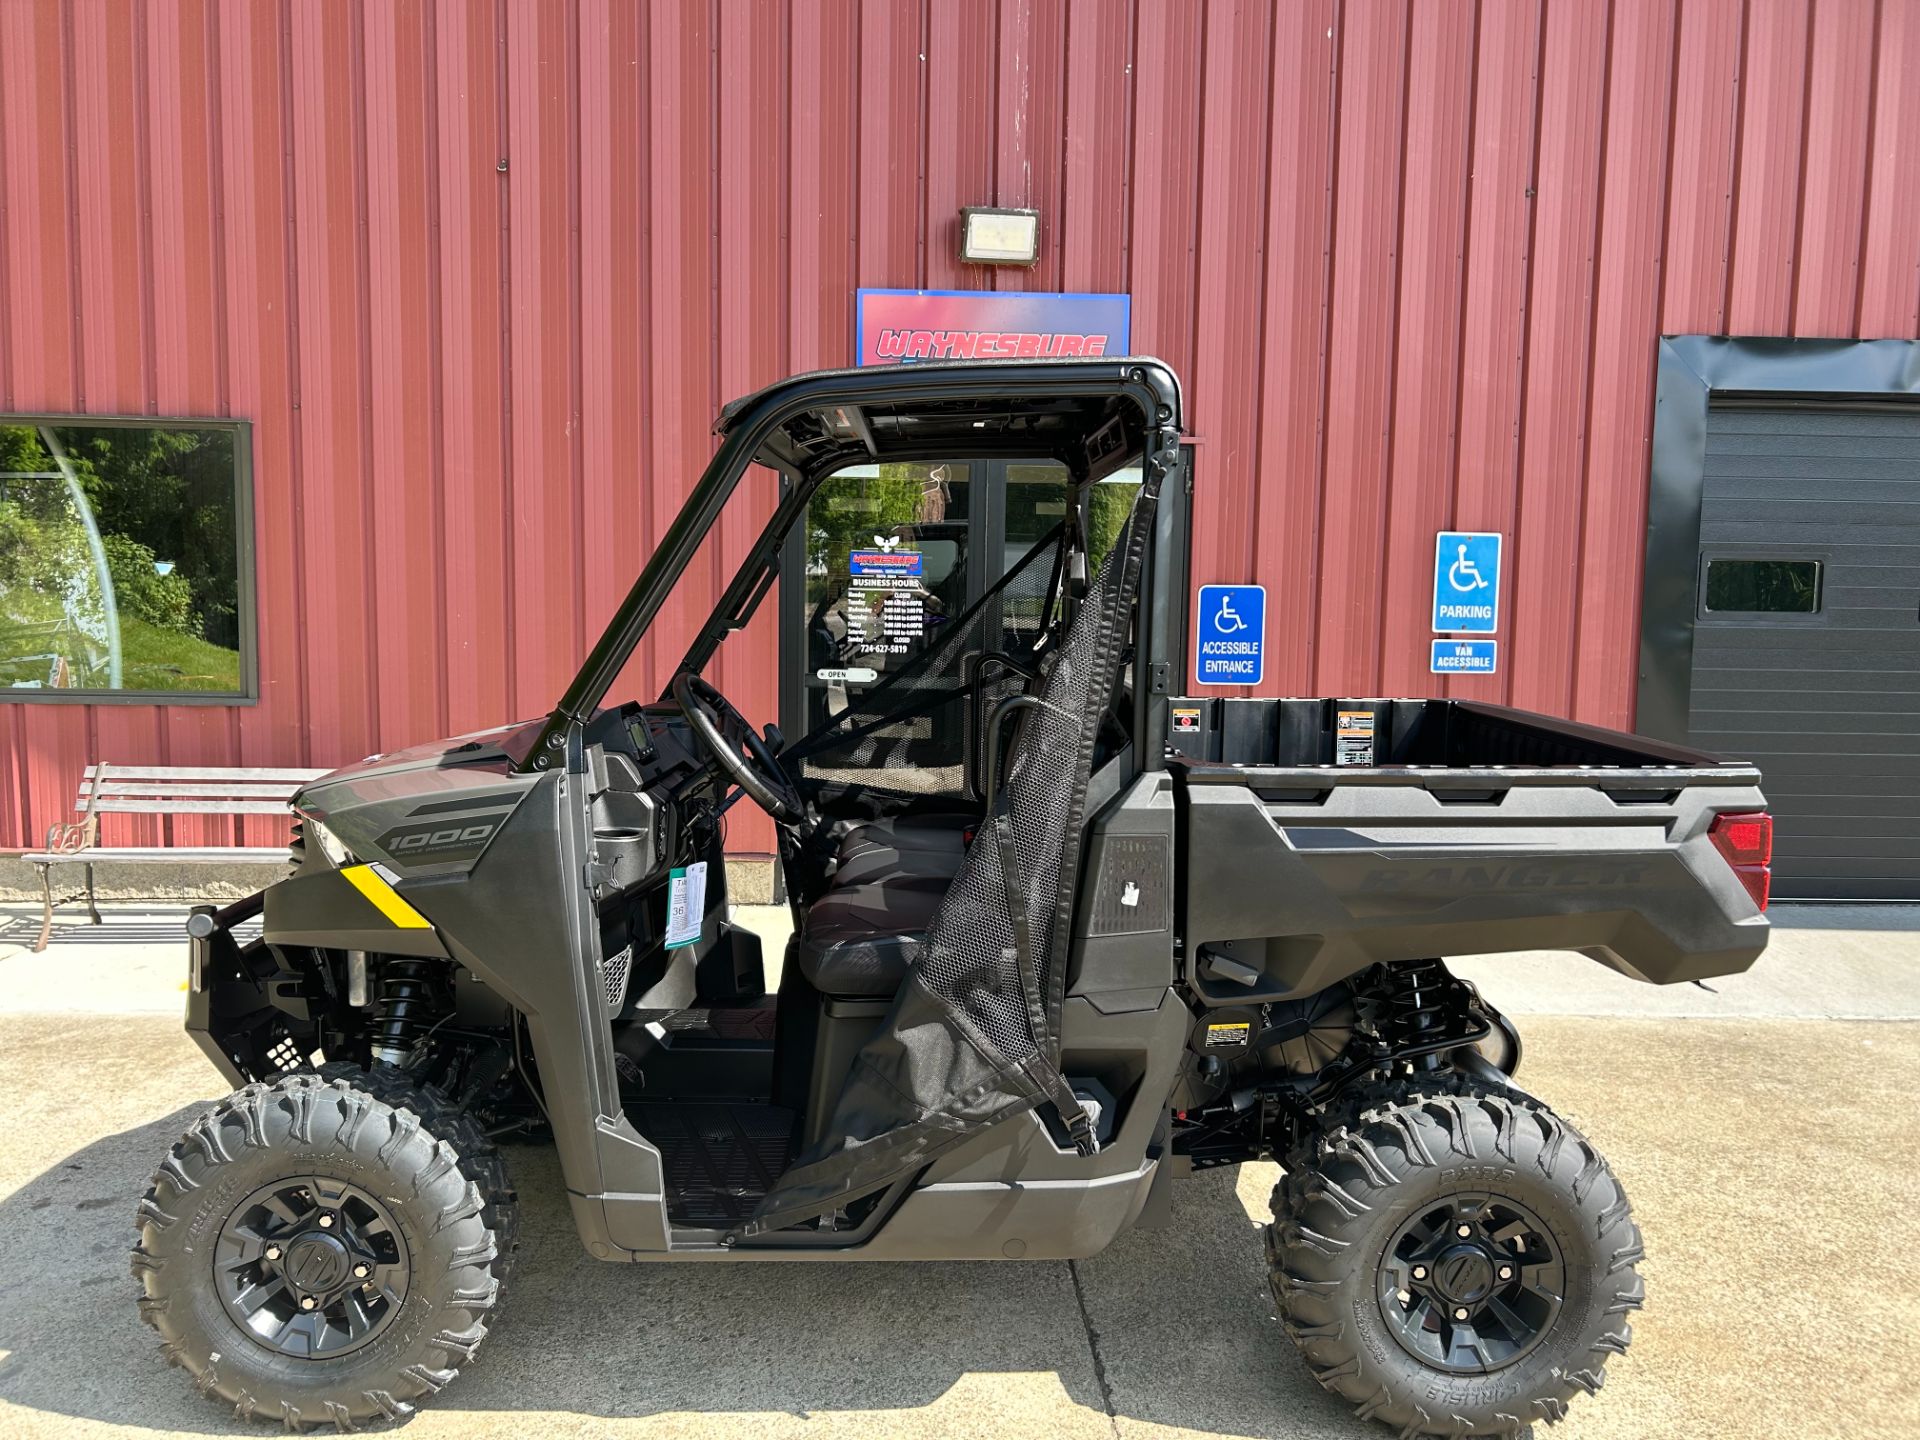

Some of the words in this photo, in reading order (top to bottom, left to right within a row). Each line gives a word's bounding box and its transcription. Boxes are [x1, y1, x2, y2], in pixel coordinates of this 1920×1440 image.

[877, 329, 1107, 358] WAYNESBURG
[853, 578, 891, 587] BUSINESS
[892, 579, 919, 588] HOURS
[1439, 605, 1492, 619] PARKING
[860, 645, 908, 654] 724-627-5819
[1202, 641, 1259, 655] ACCESSIBLE
[1455, 646, 1472, 656] VAN
[1205, 660, 1254, 673] ENTRANCE
[1437, 657, 1490, 667] ACCESSIBLE
[388, 824, 493, 850] 1000
[1361, 862, 1654, 890] RANGER
